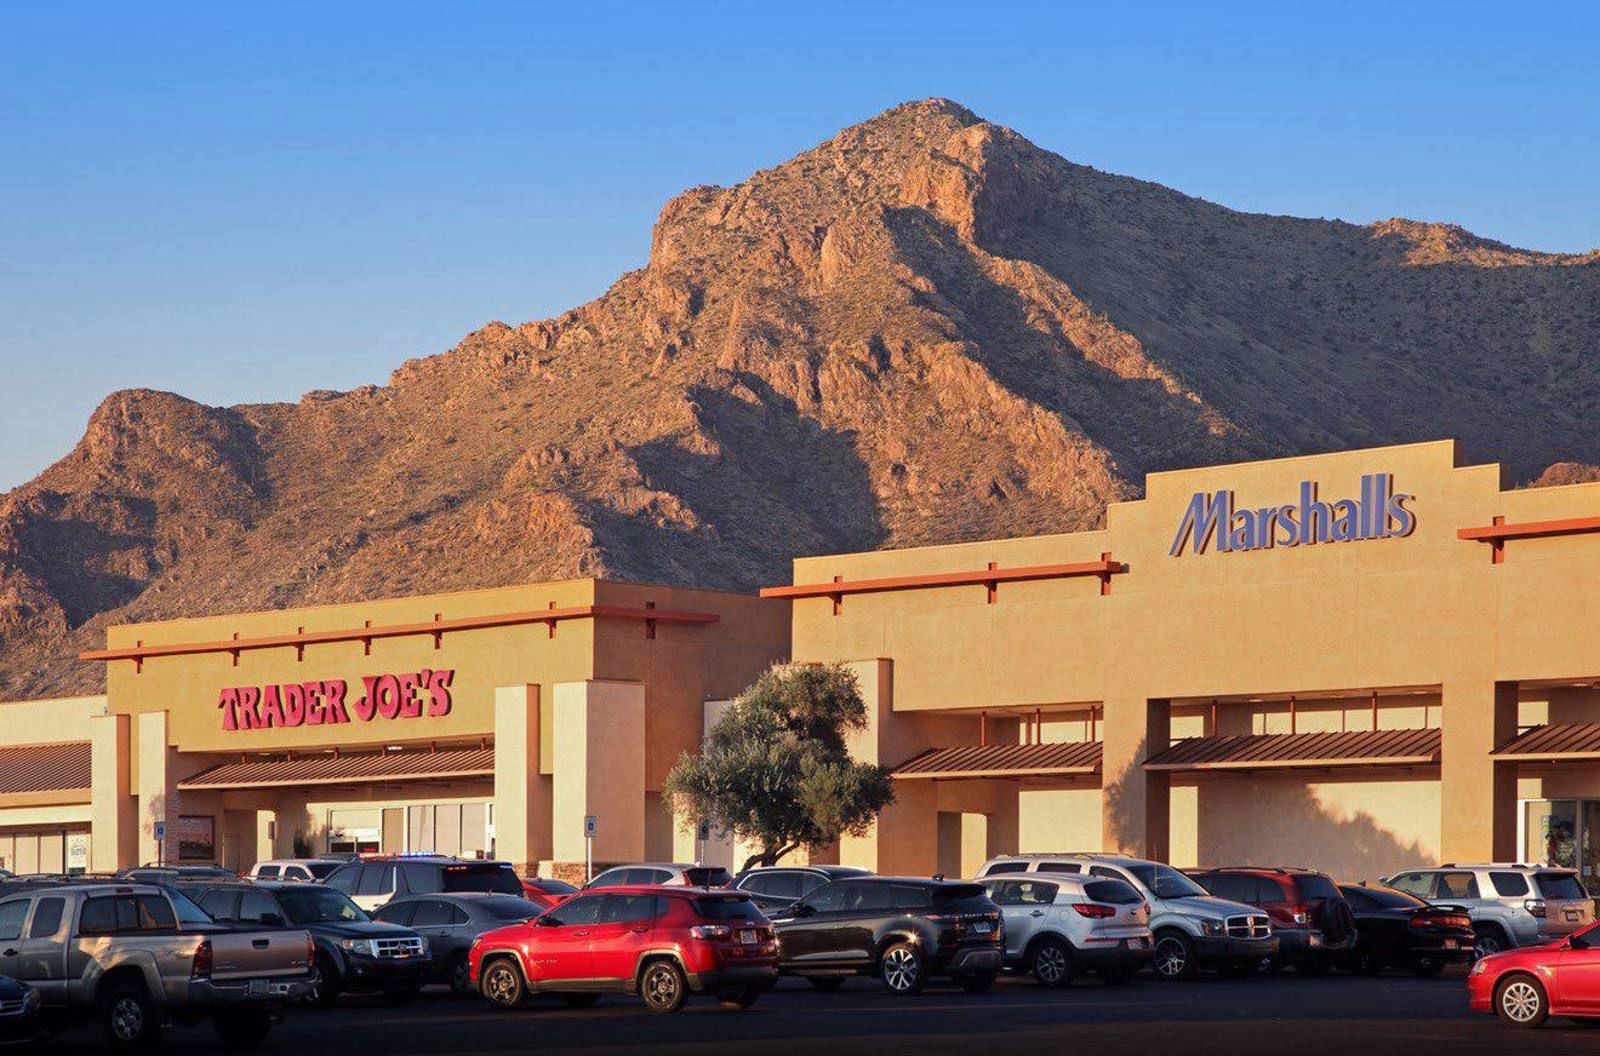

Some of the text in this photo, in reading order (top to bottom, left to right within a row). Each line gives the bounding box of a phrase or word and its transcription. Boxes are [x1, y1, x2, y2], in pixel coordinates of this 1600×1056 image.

[1169, 473, 1416, 557] Marshalls
[218, 669, 455, 730] TRADER JOE'S
